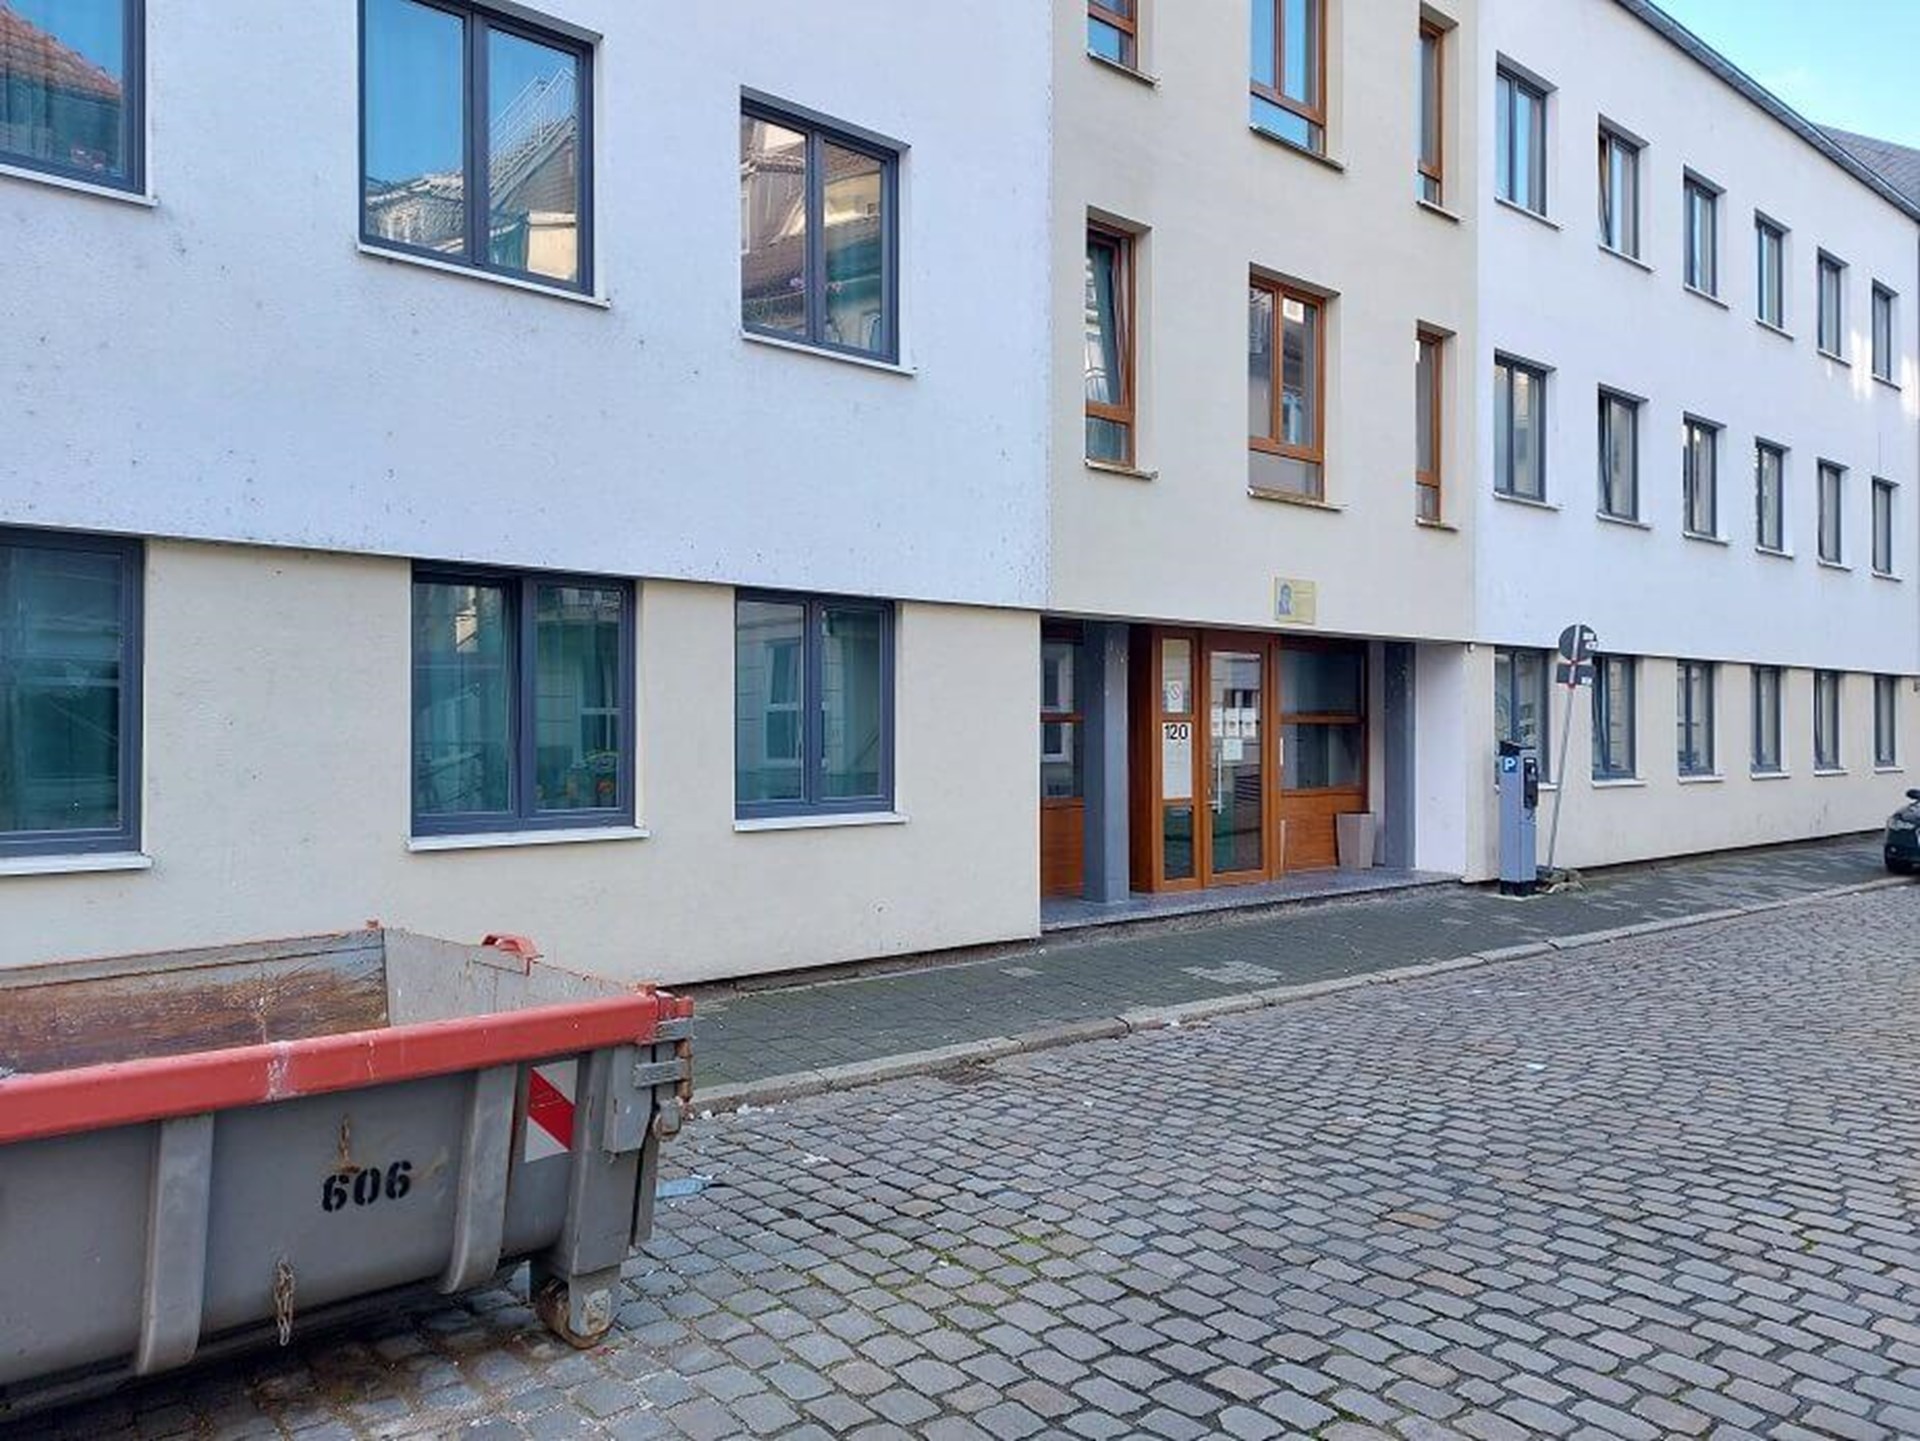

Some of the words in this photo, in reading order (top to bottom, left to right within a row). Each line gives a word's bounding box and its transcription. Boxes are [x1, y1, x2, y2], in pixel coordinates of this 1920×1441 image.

[1165, 724, 1188, 740] 120
[1504, 757, 1516, 770] P
[322, 1160, 412, 1212] 606
